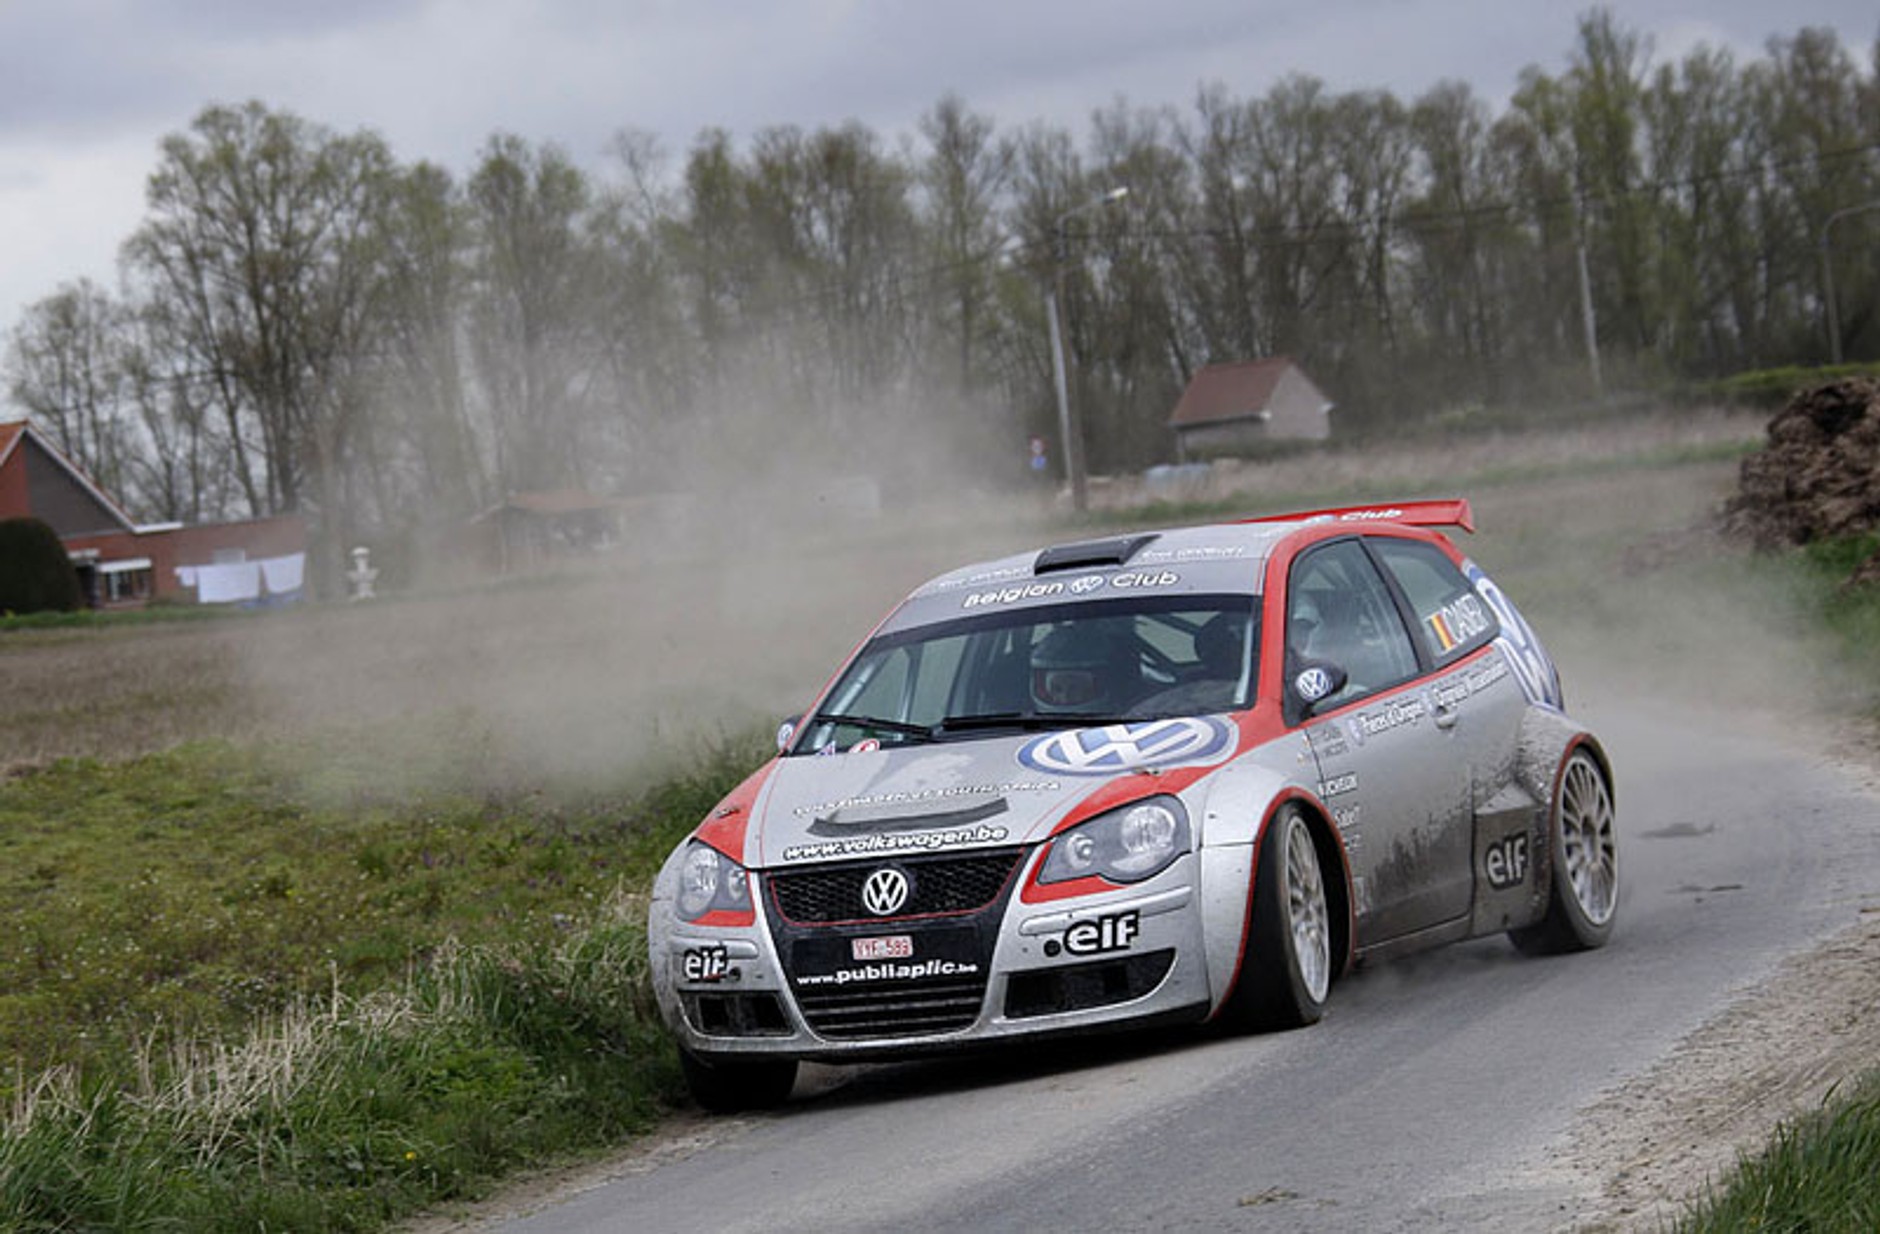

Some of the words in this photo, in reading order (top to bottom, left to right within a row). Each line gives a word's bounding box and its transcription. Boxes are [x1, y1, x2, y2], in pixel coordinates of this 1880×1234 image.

[1340, 508, 1403, 522] Club
[963, 582, 1064, 608] Belgian
[1110, 571, 1180, 588] Club
[784, 826, 1008, 861] www.volkswagen.be
[1487, 837, 1526, 884] elf
[863, 869, 908, 915] VW
[1066, 913, 1138, 953] elf
[684, 949, 725, 980] elf
